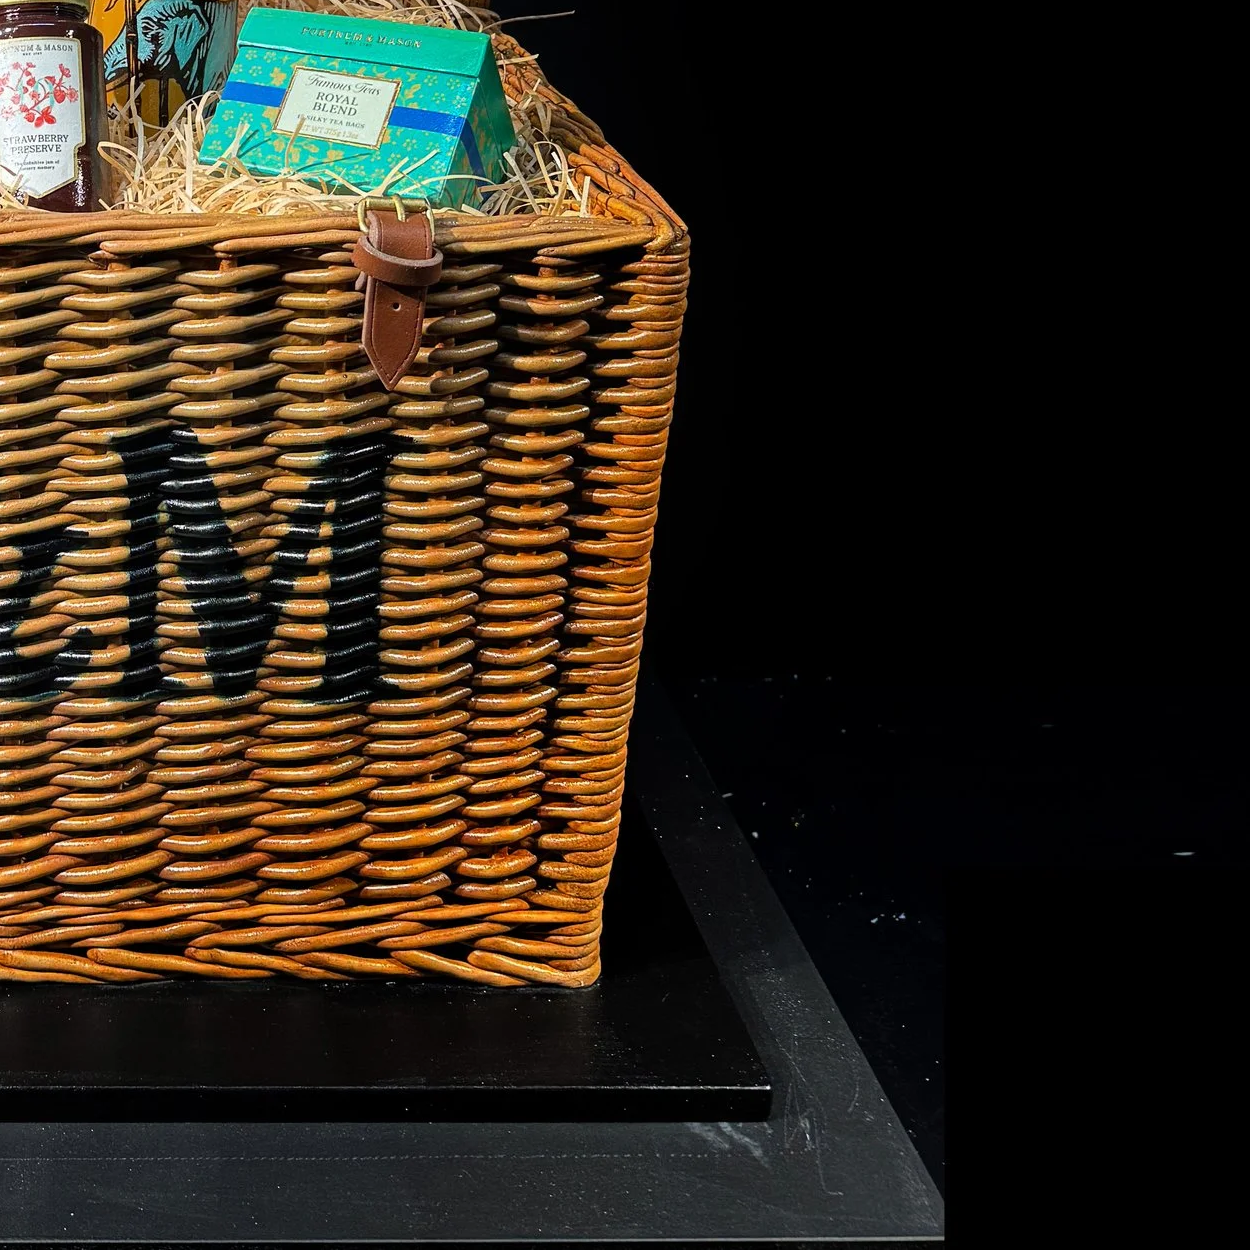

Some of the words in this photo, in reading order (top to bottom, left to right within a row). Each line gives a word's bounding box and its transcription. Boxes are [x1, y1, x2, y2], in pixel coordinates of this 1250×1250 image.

[302, 26, 363, 41] FORTNUM
[365, 34, 373, 43] &
[377, 35, 422, 48] MASON
[44, 44, 73, 52] MASON
[305, 74, 352, 91] Famous
[352, 82, 381, 96] Teas
[316, 92, 359, 106] ROYAL
[312, 102, 358, 116] BLEND
[330, 118, 343, 126] TEA
[346, 121, 366, 129] BAGS
[3, 134, 69, 146] STRAWBERRY
[11, 144, 62, 155] PRESERVE
